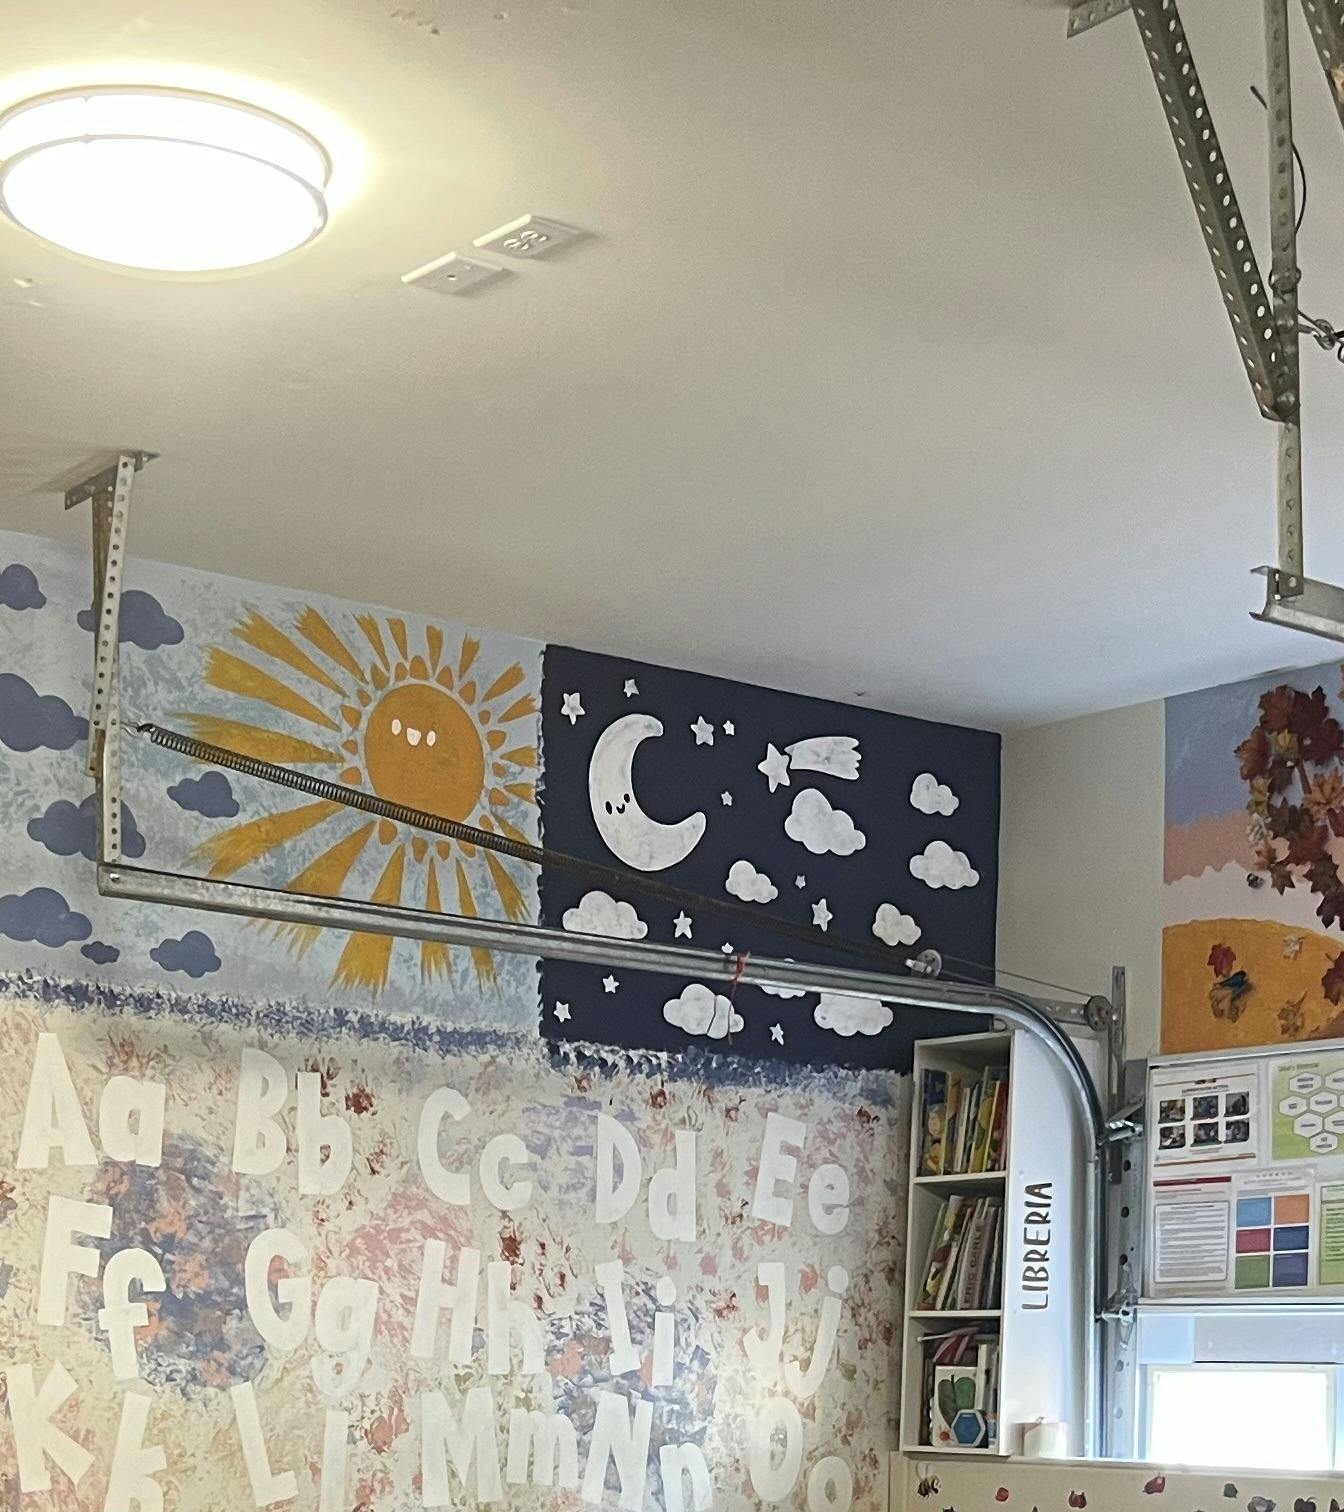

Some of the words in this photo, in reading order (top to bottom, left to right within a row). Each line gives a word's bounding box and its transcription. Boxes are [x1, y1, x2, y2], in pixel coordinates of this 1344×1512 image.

[17, 1032, 167, 1169] Aa
[232, 1048, 354, 1196] Bb
[417, 1087, 535, 1212] Cc
[595, 1112, 698, 1243] Dd
[753, 1112, 851, 1235] Ee
[37, 1196, 167, 1381] Ff
[245, 1227, 380, 1397] Gg
[411, 1239, 546, 1376] Hh
[594, 1261, 676, 1387] Ii
[743, 1262, 848, 1399] Jj
[1021, 1182, 1054, 1311] LIBRERIA
[419, 1387, 579, 1507] Mm
